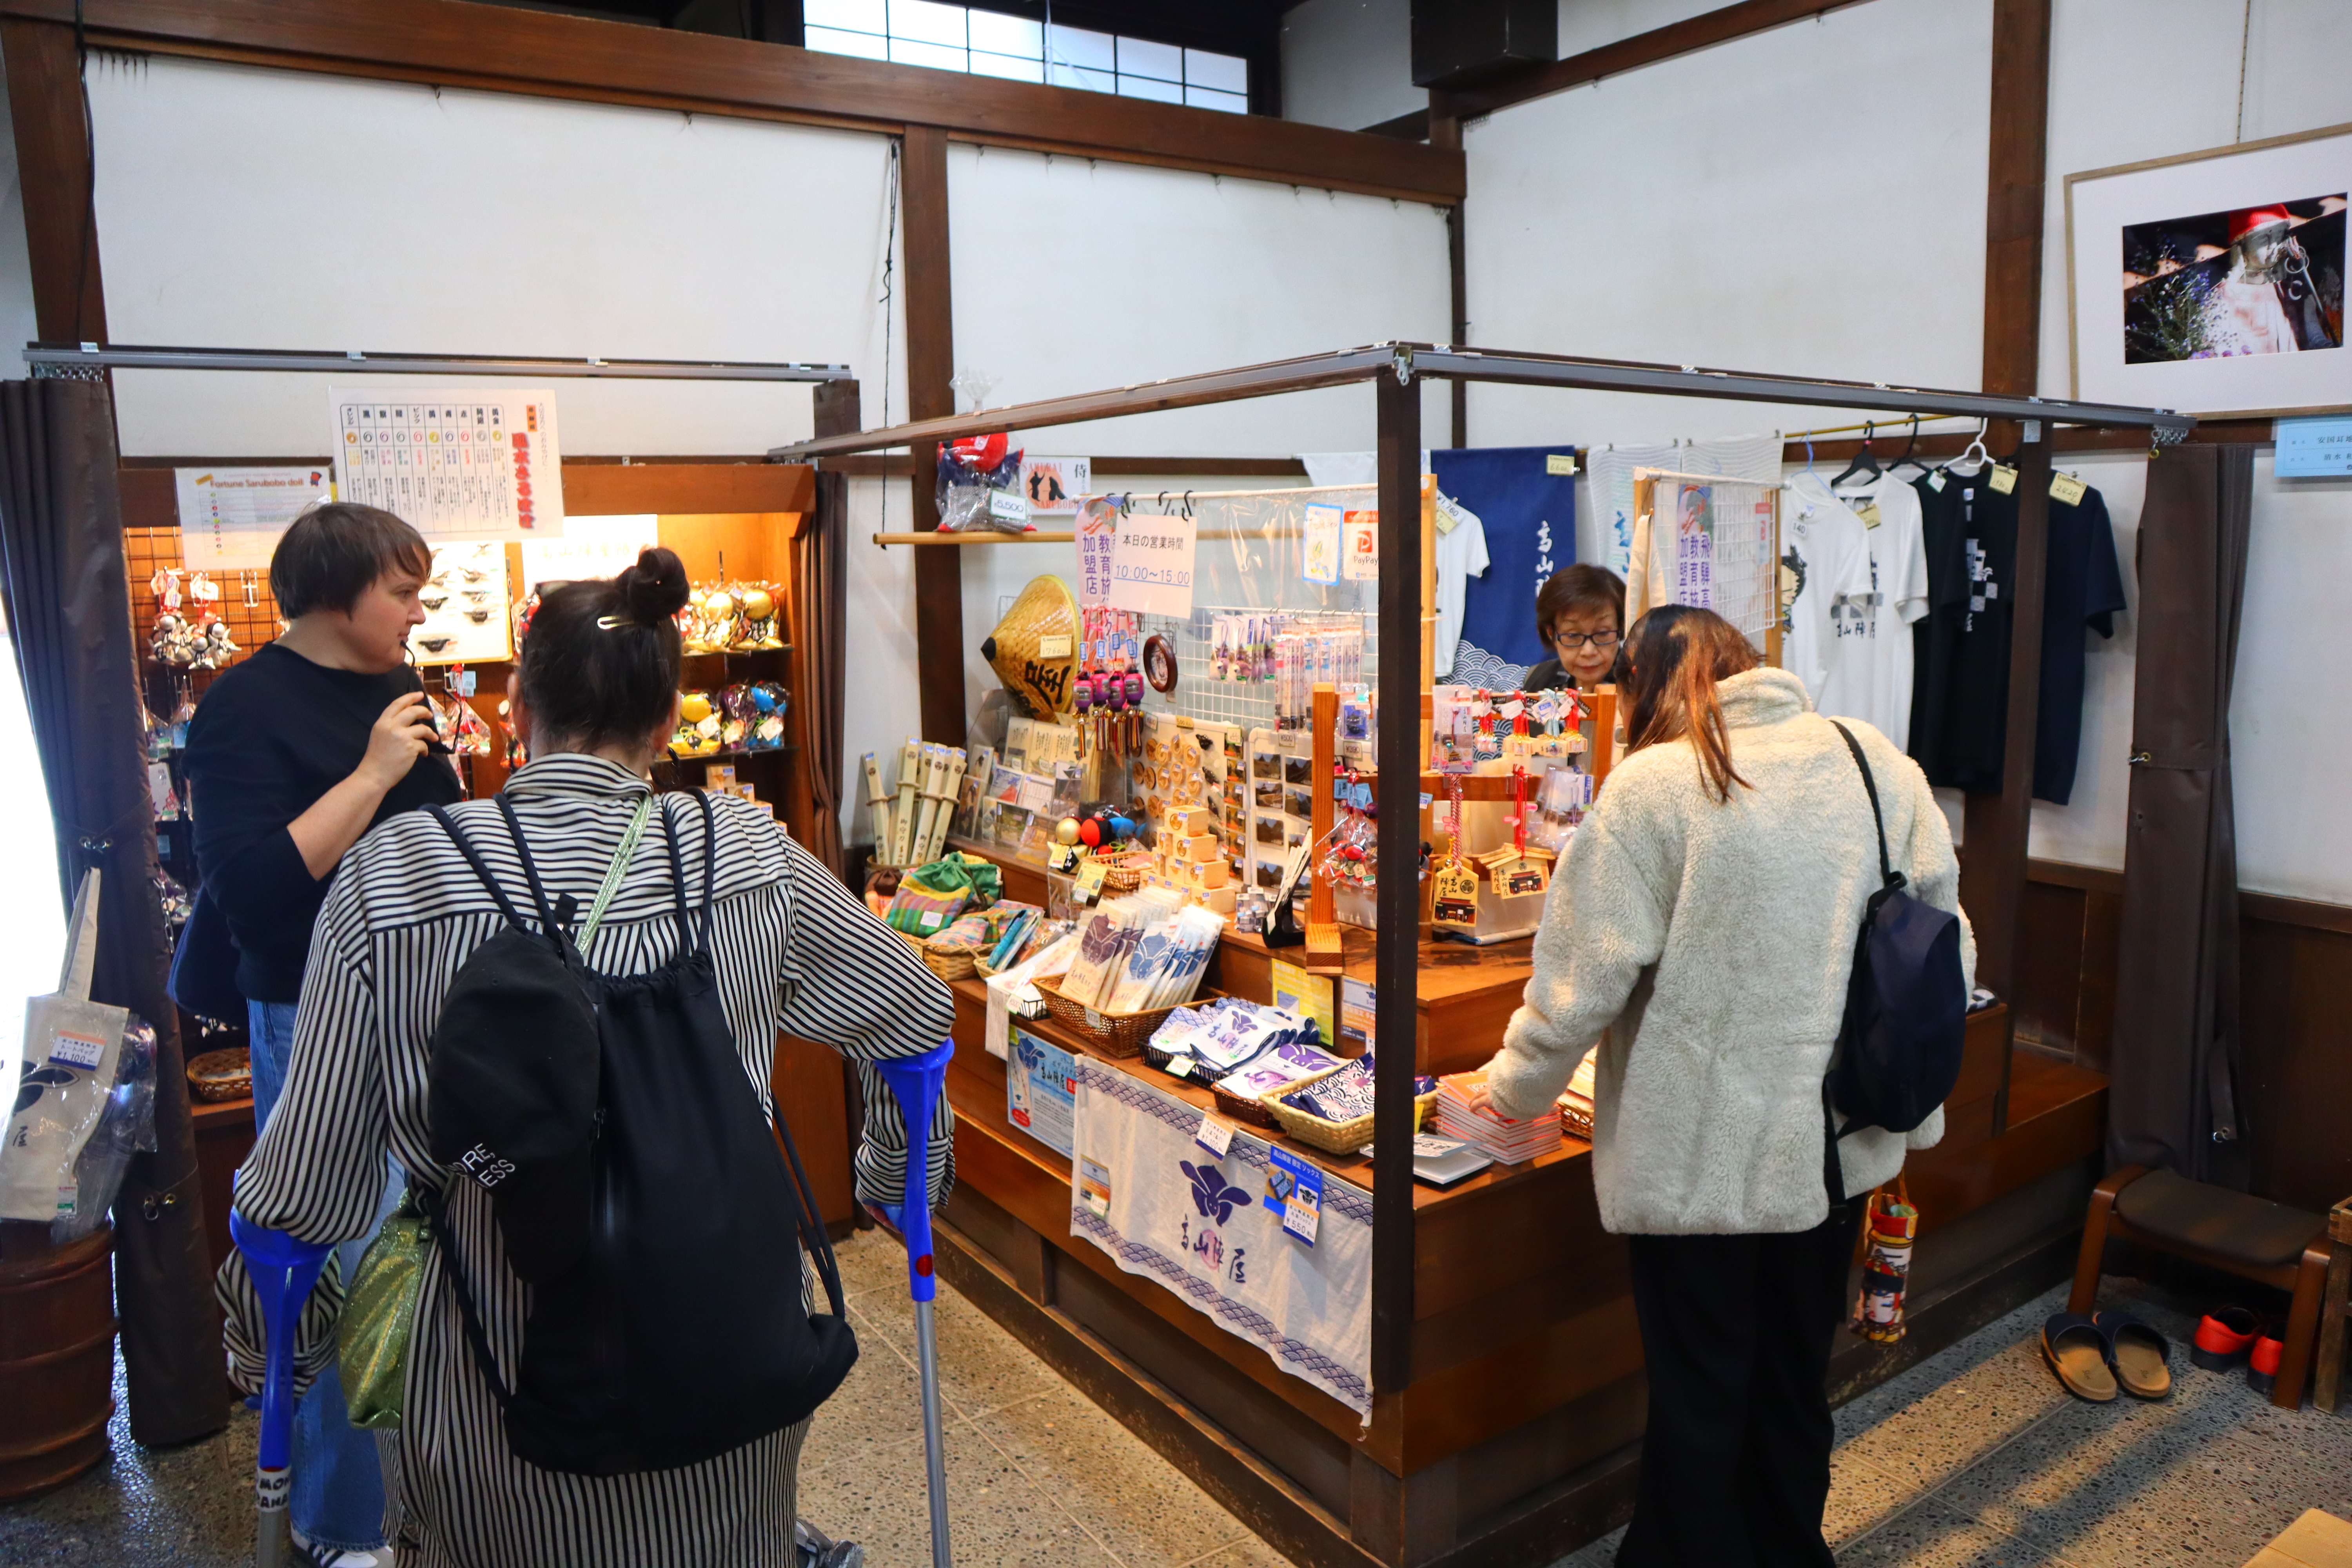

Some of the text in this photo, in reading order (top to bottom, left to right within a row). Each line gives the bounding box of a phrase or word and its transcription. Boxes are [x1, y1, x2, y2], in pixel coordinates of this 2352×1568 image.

[1022, 462, 1062, 472] SAMURAI
[1074, 464, 1087, 478] 侍
[210, 479, 244, 488] Fortune
[245, 479, 286, 488] Sarubobo
[288, 477, 303, 486] doll
[1123, 534, 1185, 551] 本日の営業時間
[538, 542, 648, 559] 高山陣屋限
[1083, 534, 1098, 595] 加盟店
[1354, 555, 1379, 566] PayPay
[57, 1051, 86, 1063] ¥1,100
[61, 1044, 95, 1056] トートバッグ
[1201, 1134, 1218, 1149] ¥1,100
[1274, 1149, 1320, 1179] 高山陣屋 限定 ソックス
[478, 1159, 516, 1187] ESS
[1181, 1213, 1246, 1283] 高山陣屋
